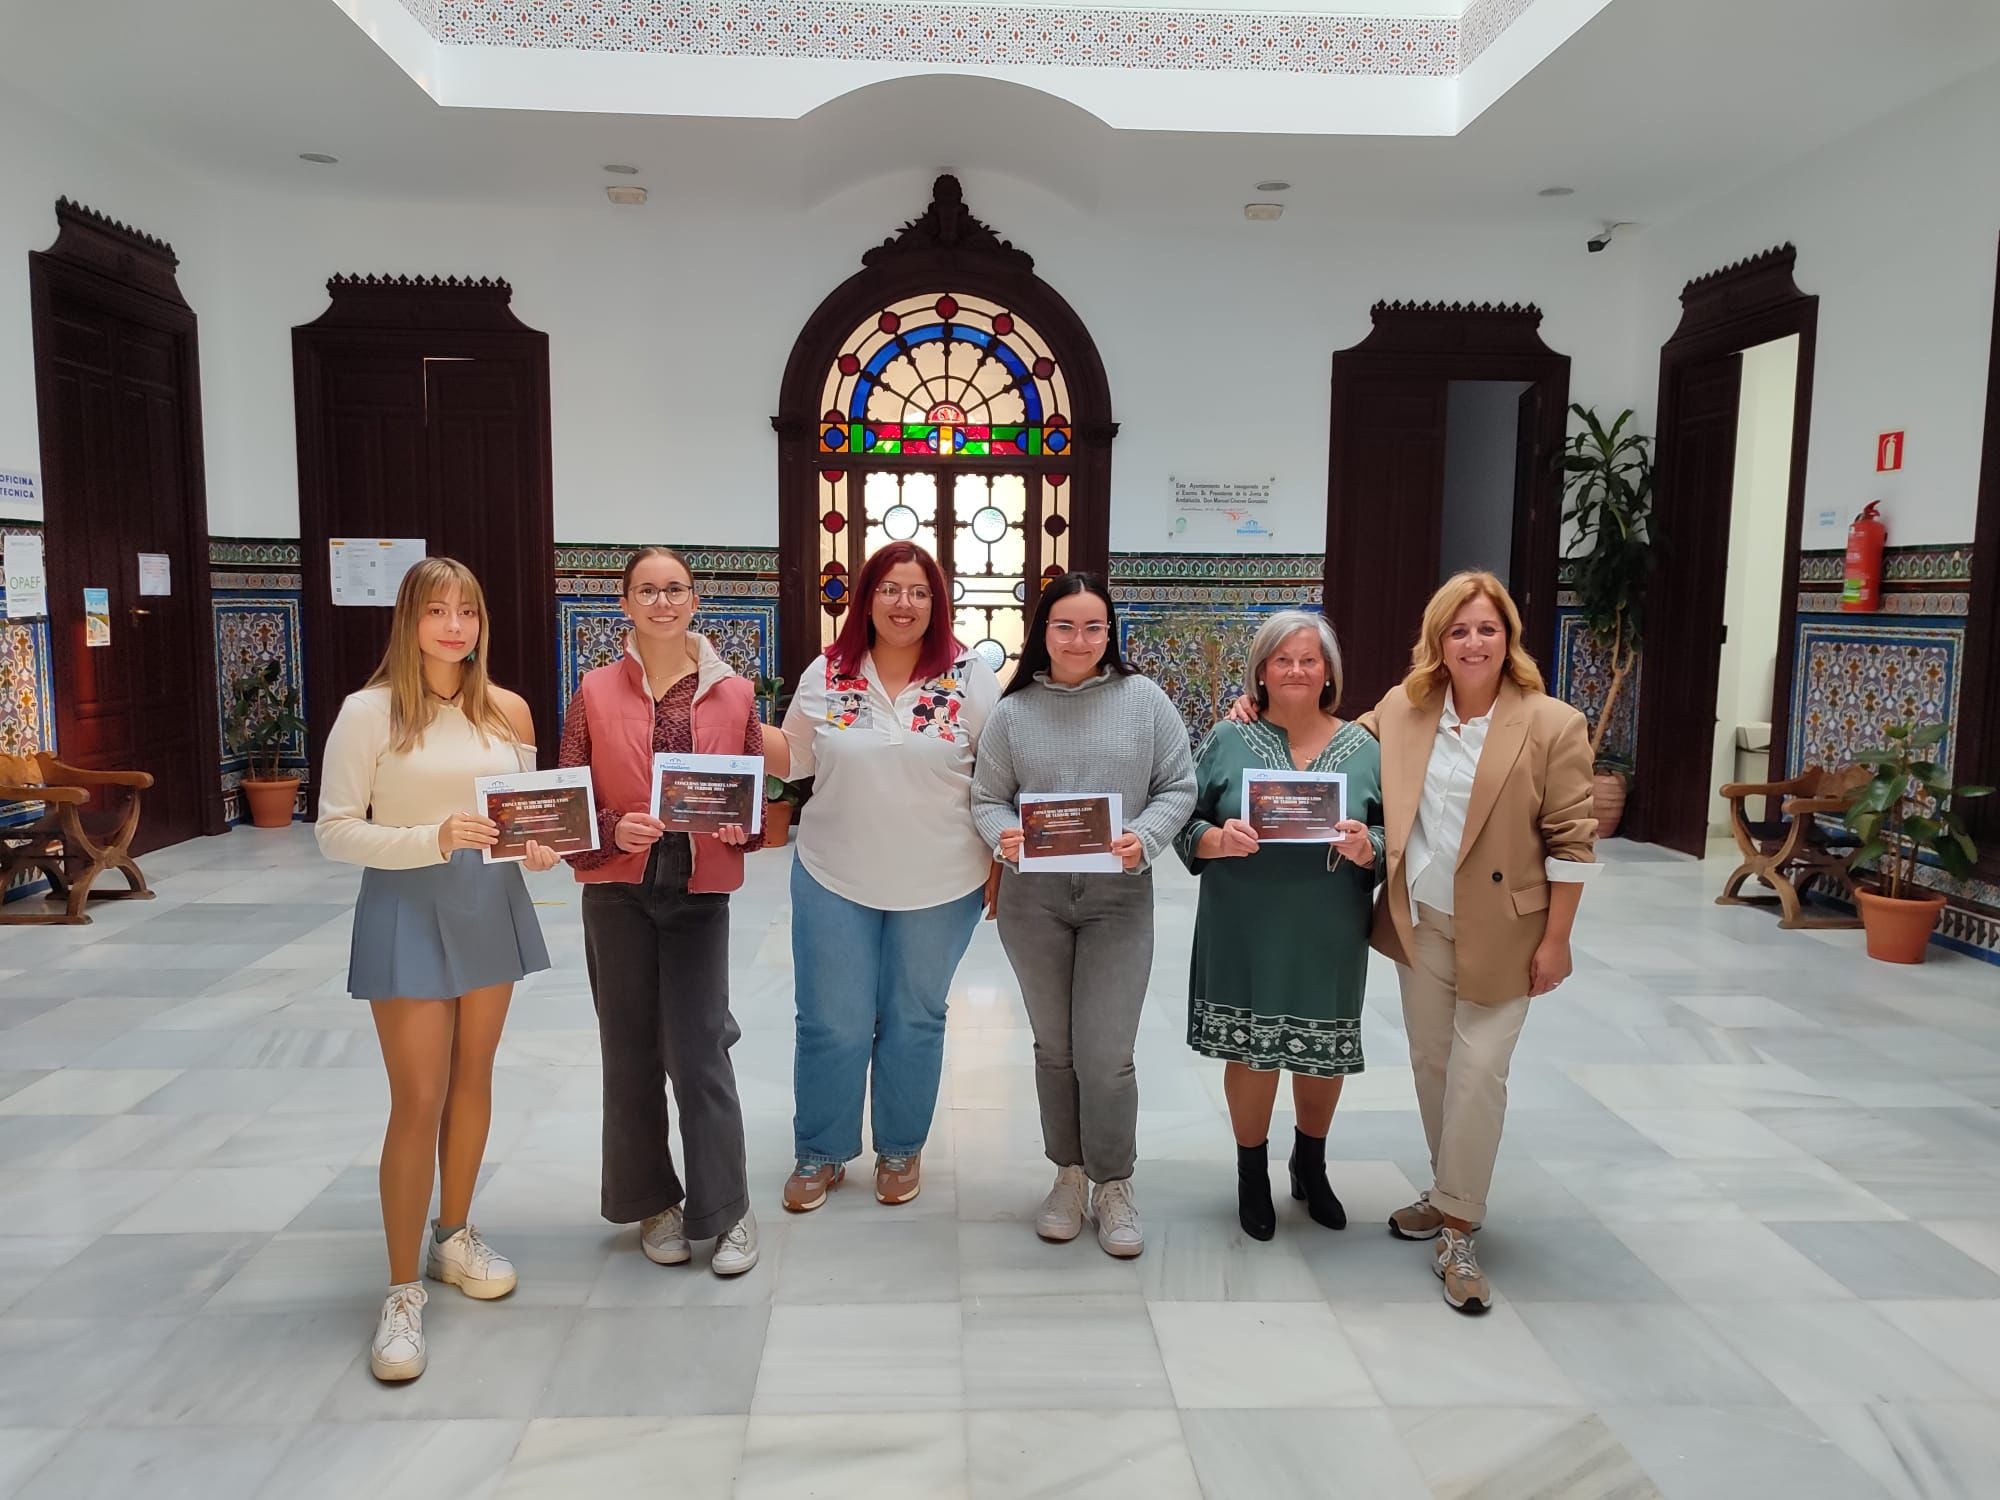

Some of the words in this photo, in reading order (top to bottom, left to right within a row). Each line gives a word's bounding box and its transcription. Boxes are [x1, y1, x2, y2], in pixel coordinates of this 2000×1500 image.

[0, 474, 34, 486] OFICINA
[0, 487, 34, 498] TECNICA
[10, 576, 41, 590] OPAEF
